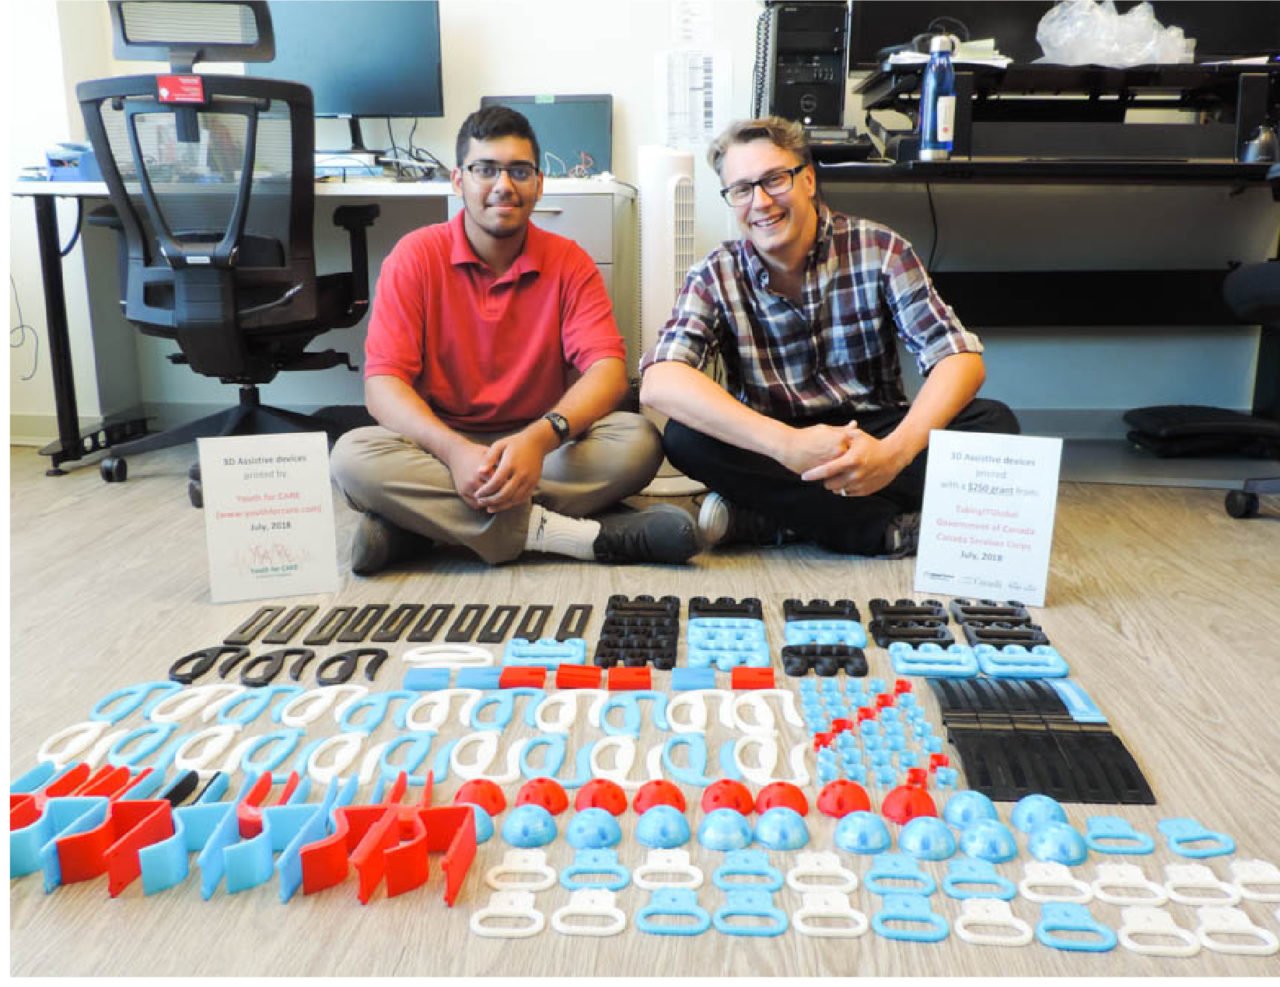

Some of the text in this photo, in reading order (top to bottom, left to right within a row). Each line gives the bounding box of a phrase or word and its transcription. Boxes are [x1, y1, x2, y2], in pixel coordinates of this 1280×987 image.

[238, 457, 273, 465] Assistive
[276, 455, 307, 463] devices
[964, 453, 1002, 464] Assistive
[1003, 456, 1036, 467] devices
